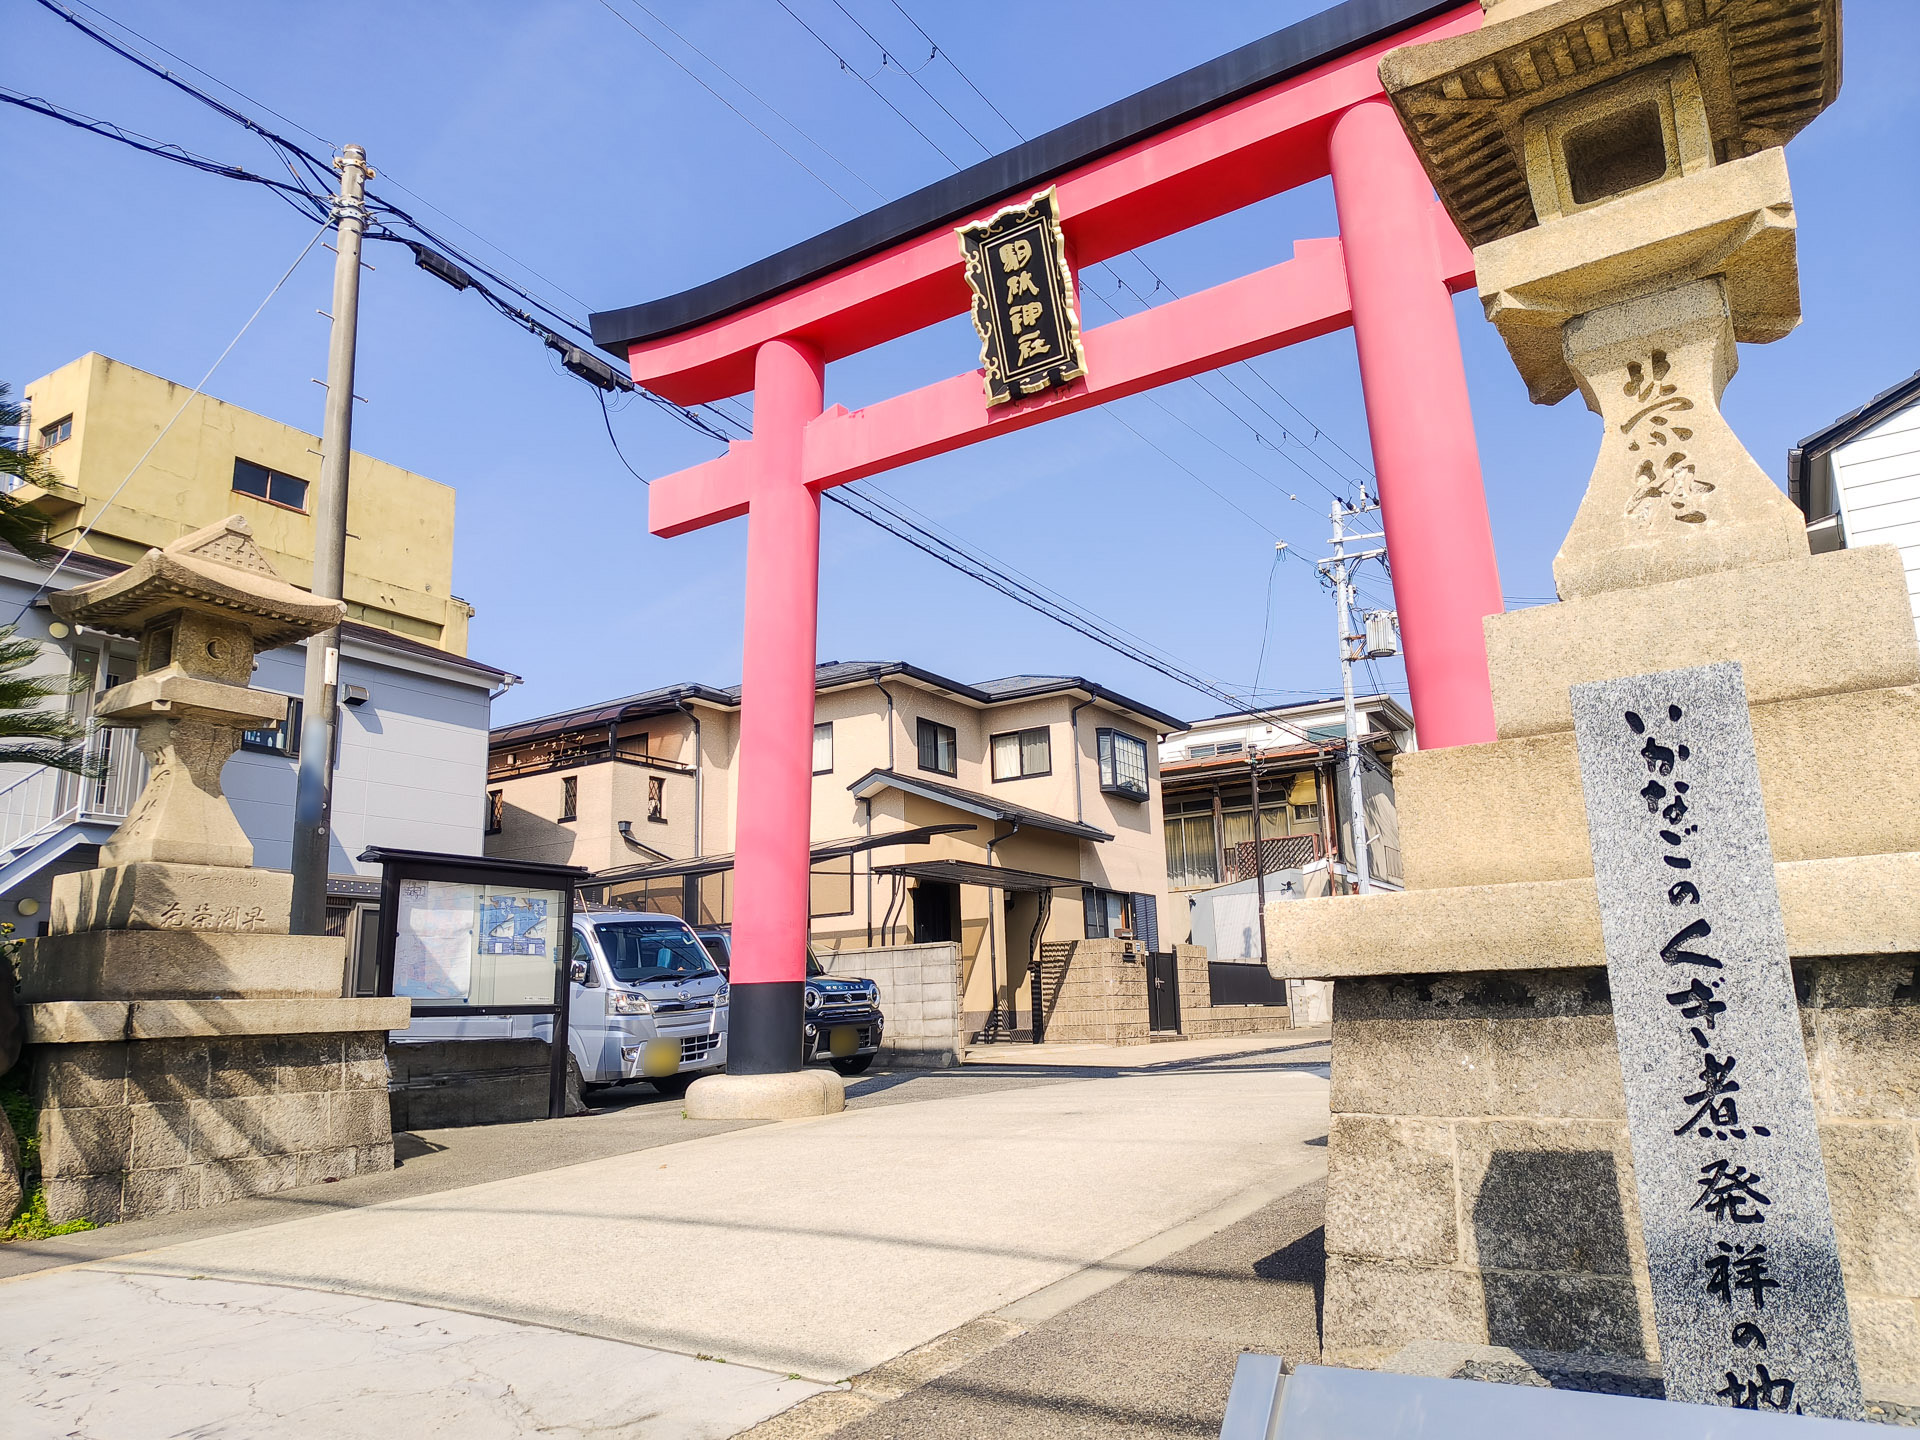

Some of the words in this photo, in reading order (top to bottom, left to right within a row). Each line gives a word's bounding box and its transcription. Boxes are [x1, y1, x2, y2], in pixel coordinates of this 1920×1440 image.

[1624, 703, 1802, 1416] いかなごのくぎ煮発祥の地
